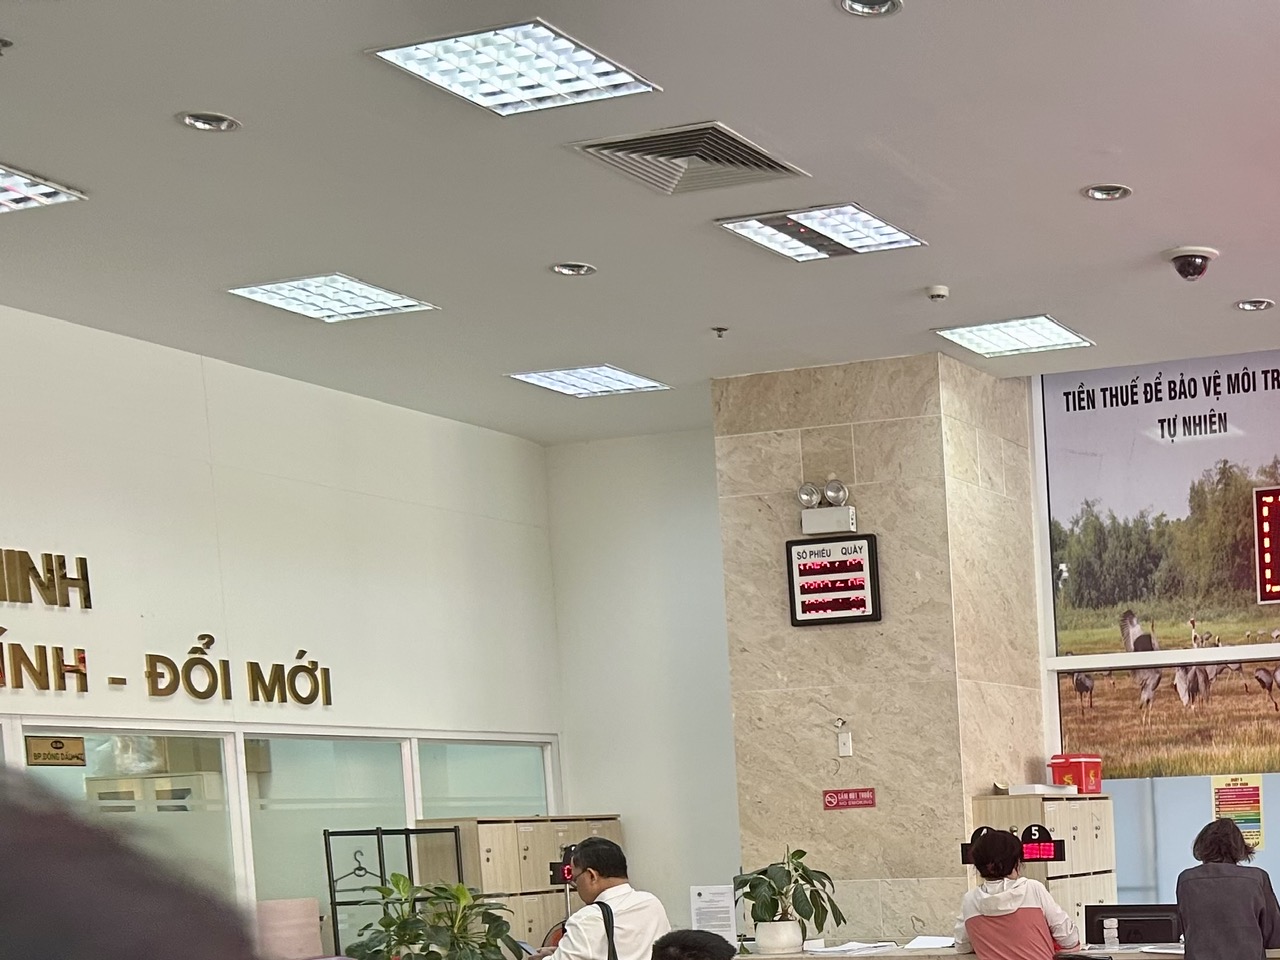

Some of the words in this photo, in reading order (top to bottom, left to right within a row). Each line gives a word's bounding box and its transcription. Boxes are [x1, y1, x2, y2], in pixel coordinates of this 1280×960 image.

[1063, 382, 1096, 412] TIỀN
[1100, 376, 1139, 408] THUẾ
[1143, 372, 1163, 404] ĐỂ
[1168, 372, 1198, 401] BẢO
[1202, 370, 1221, 401] VỆ
[1226, 368, 1257, 395] MÔI
[1158, 414, 1178, 443] TỰ
[1182, 408, 1228, 437] NHIÊN
[0, 547, 92, 610] INH
[144, 633, 232, 701] ĐỔI
[246, 650, 332, 706] MỚI
[1031, 826, 1040, 840] 5
